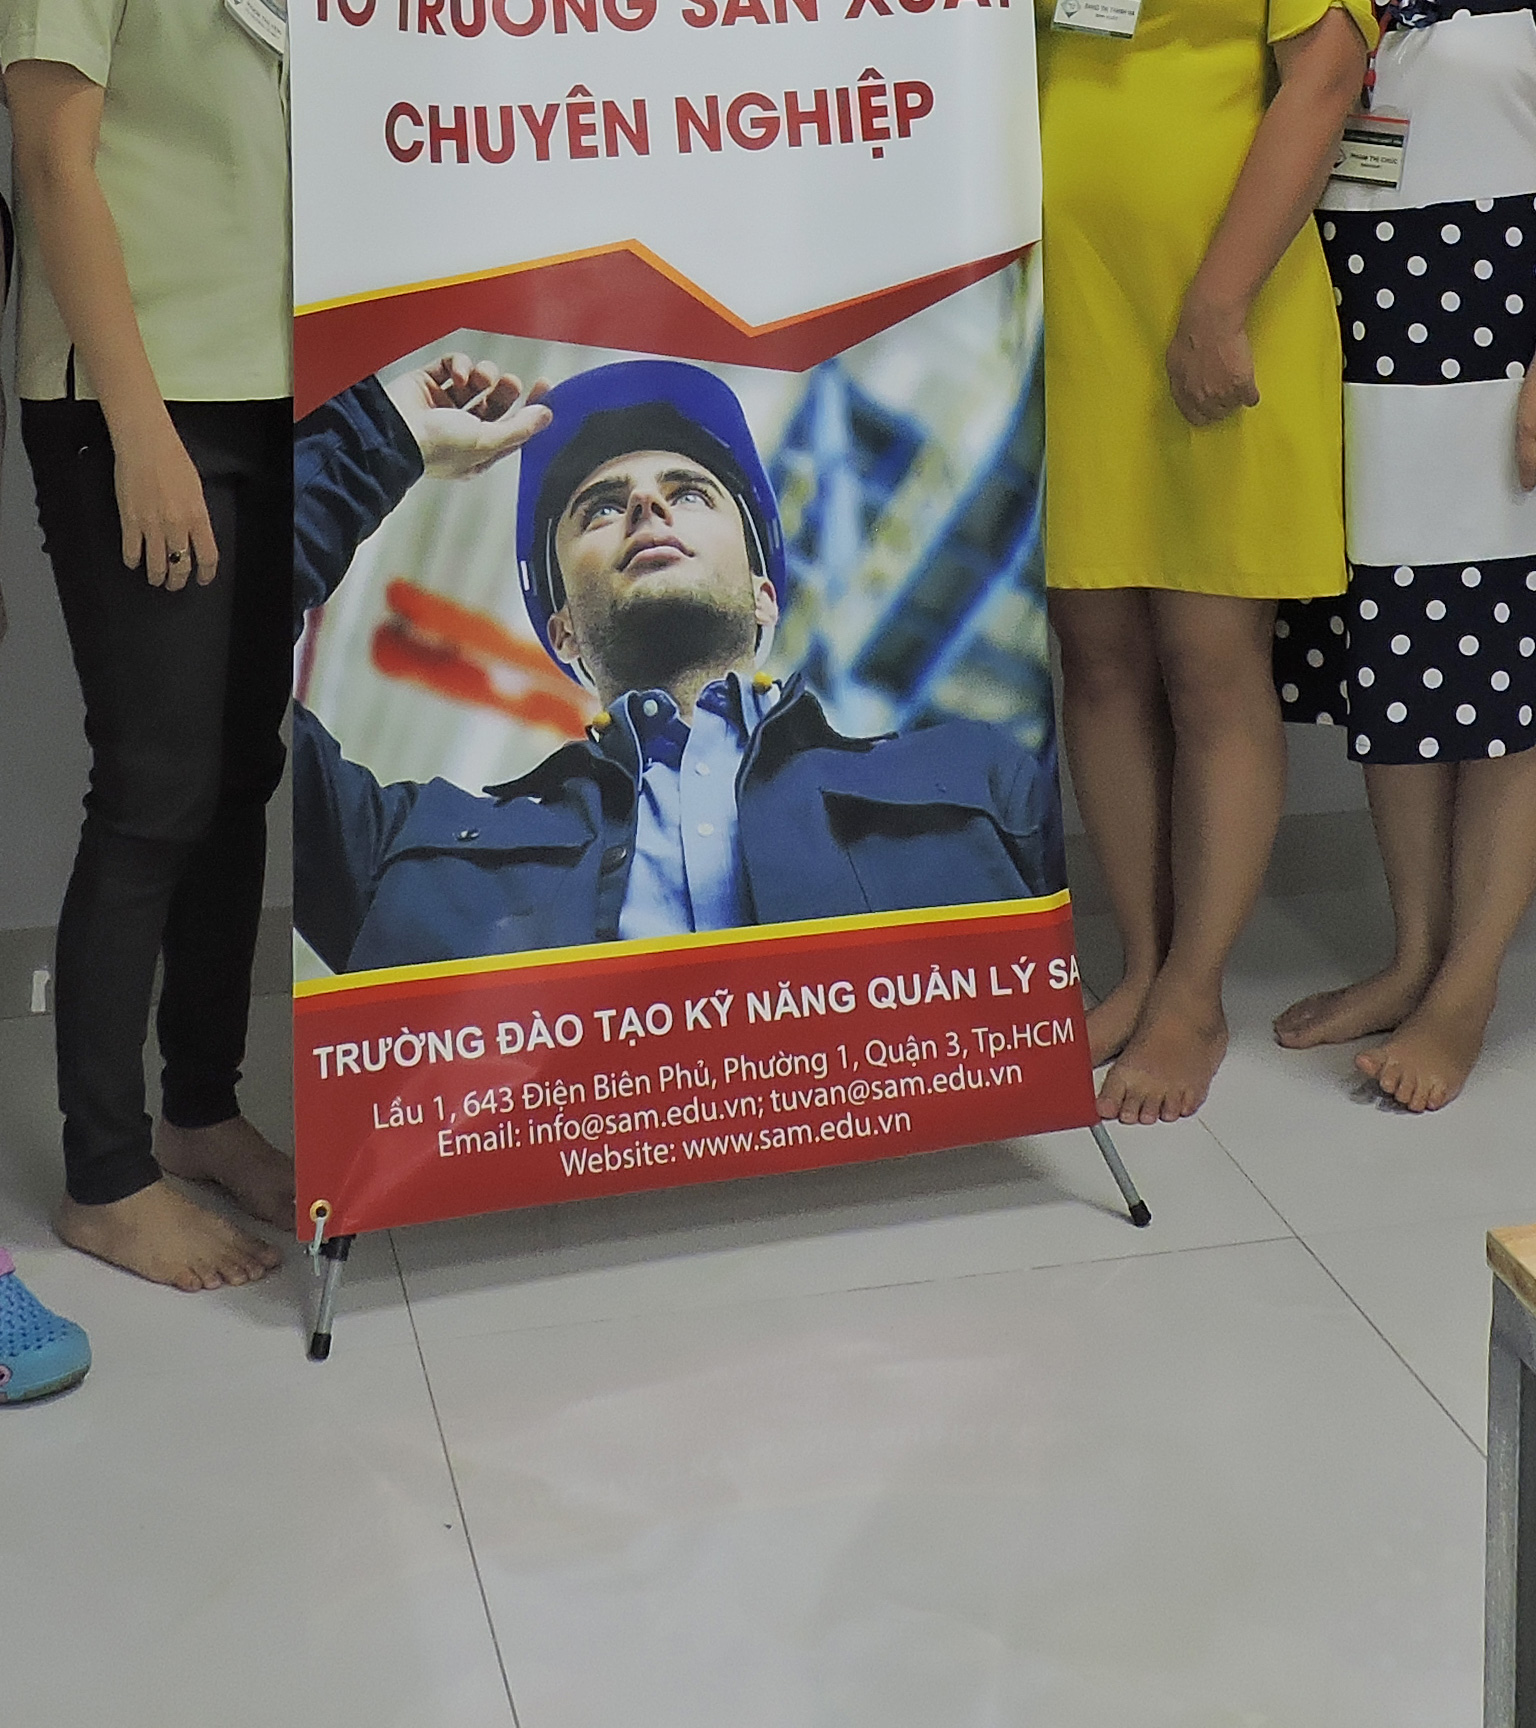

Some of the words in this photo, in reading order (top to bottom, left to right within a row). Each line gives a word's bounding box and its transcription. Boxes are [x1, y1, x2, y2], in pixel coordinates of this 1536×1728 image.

[384, 84, 652, 165] CHUYÊN
[674, 66, 935, 160] NGHIỆP
[312, 1026, 486, 1080] TRƯỜNG
[495, 1010, 584, 1056] ĐÀO
[593, 1002, 674, 1047] TẠO
[684, 989, 735, 1032] KỸ
[746, 980, 857, 1025] NĂNG
[867, 964, 977, 1011] QUẢN
[989, 955, 1037, 997] LÝ
[372, 1095, 424, 1130] Lầu
[432, 1095, 457, 1124] 1,
[463, 1086, 515, 1119] 643
[522, 1079, 586, 1113] Điện
[593, 1069, 652, 1102] Biên
[659, 1058, 718, 1093] Phủ,
[723, 1048, 829, 1085] Phường
[836, 1043, 860, 1074] 1,
[864, 1034, 939, 1068] Quận
[945, 1031, 970, 1060] 3,
[971, 1017, 1075, 1059] Tp.HCM
[437, 1120, 522, 1158] Email:
[528, 1097, 765, 1146] info@sam.edu.vn;
[770, 1062, 1024, 1114] tuvan@sam.edu.vn
[559, 1139, 677, 1177] Website:
[682, 1111, 912, 1161] www.sam.edu.vn
